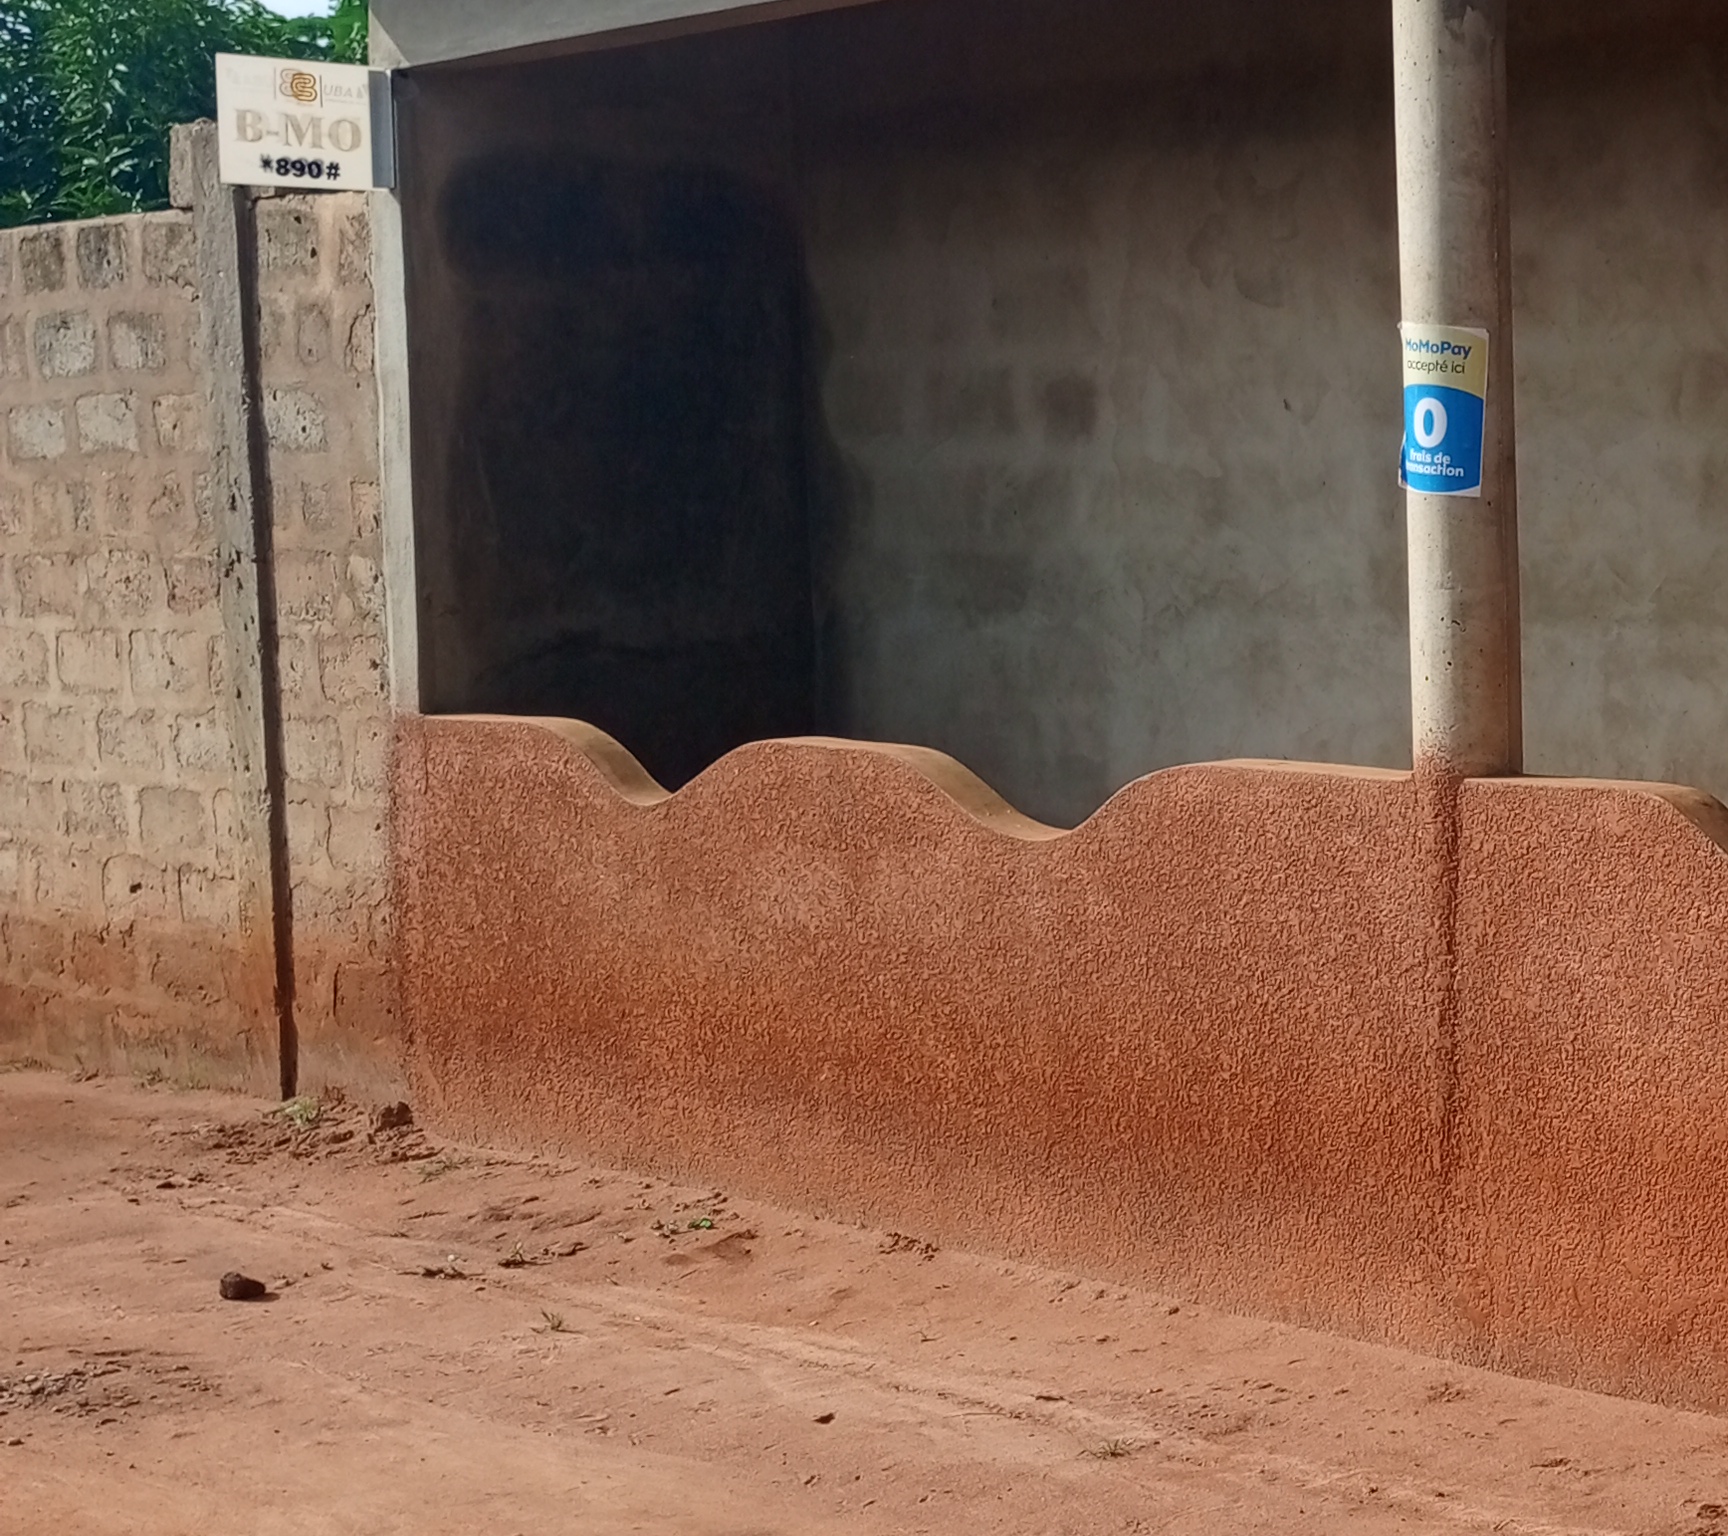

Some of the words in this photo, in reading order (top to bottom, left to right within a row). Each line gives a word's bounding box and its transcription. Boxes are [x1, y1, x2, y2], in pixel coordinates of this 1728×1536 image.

[234, 107, 363, 154] B-MO
[1404, 337, 1472, 360] MoMoPay
[1406, 357, 1449, 375] accepté
[1451, 360, 1466, 374] ici
[1413, 396, 1448, 449] 0
[1409, 448, 1432, 463] frais
[1433, 451, 1451, 465] de
